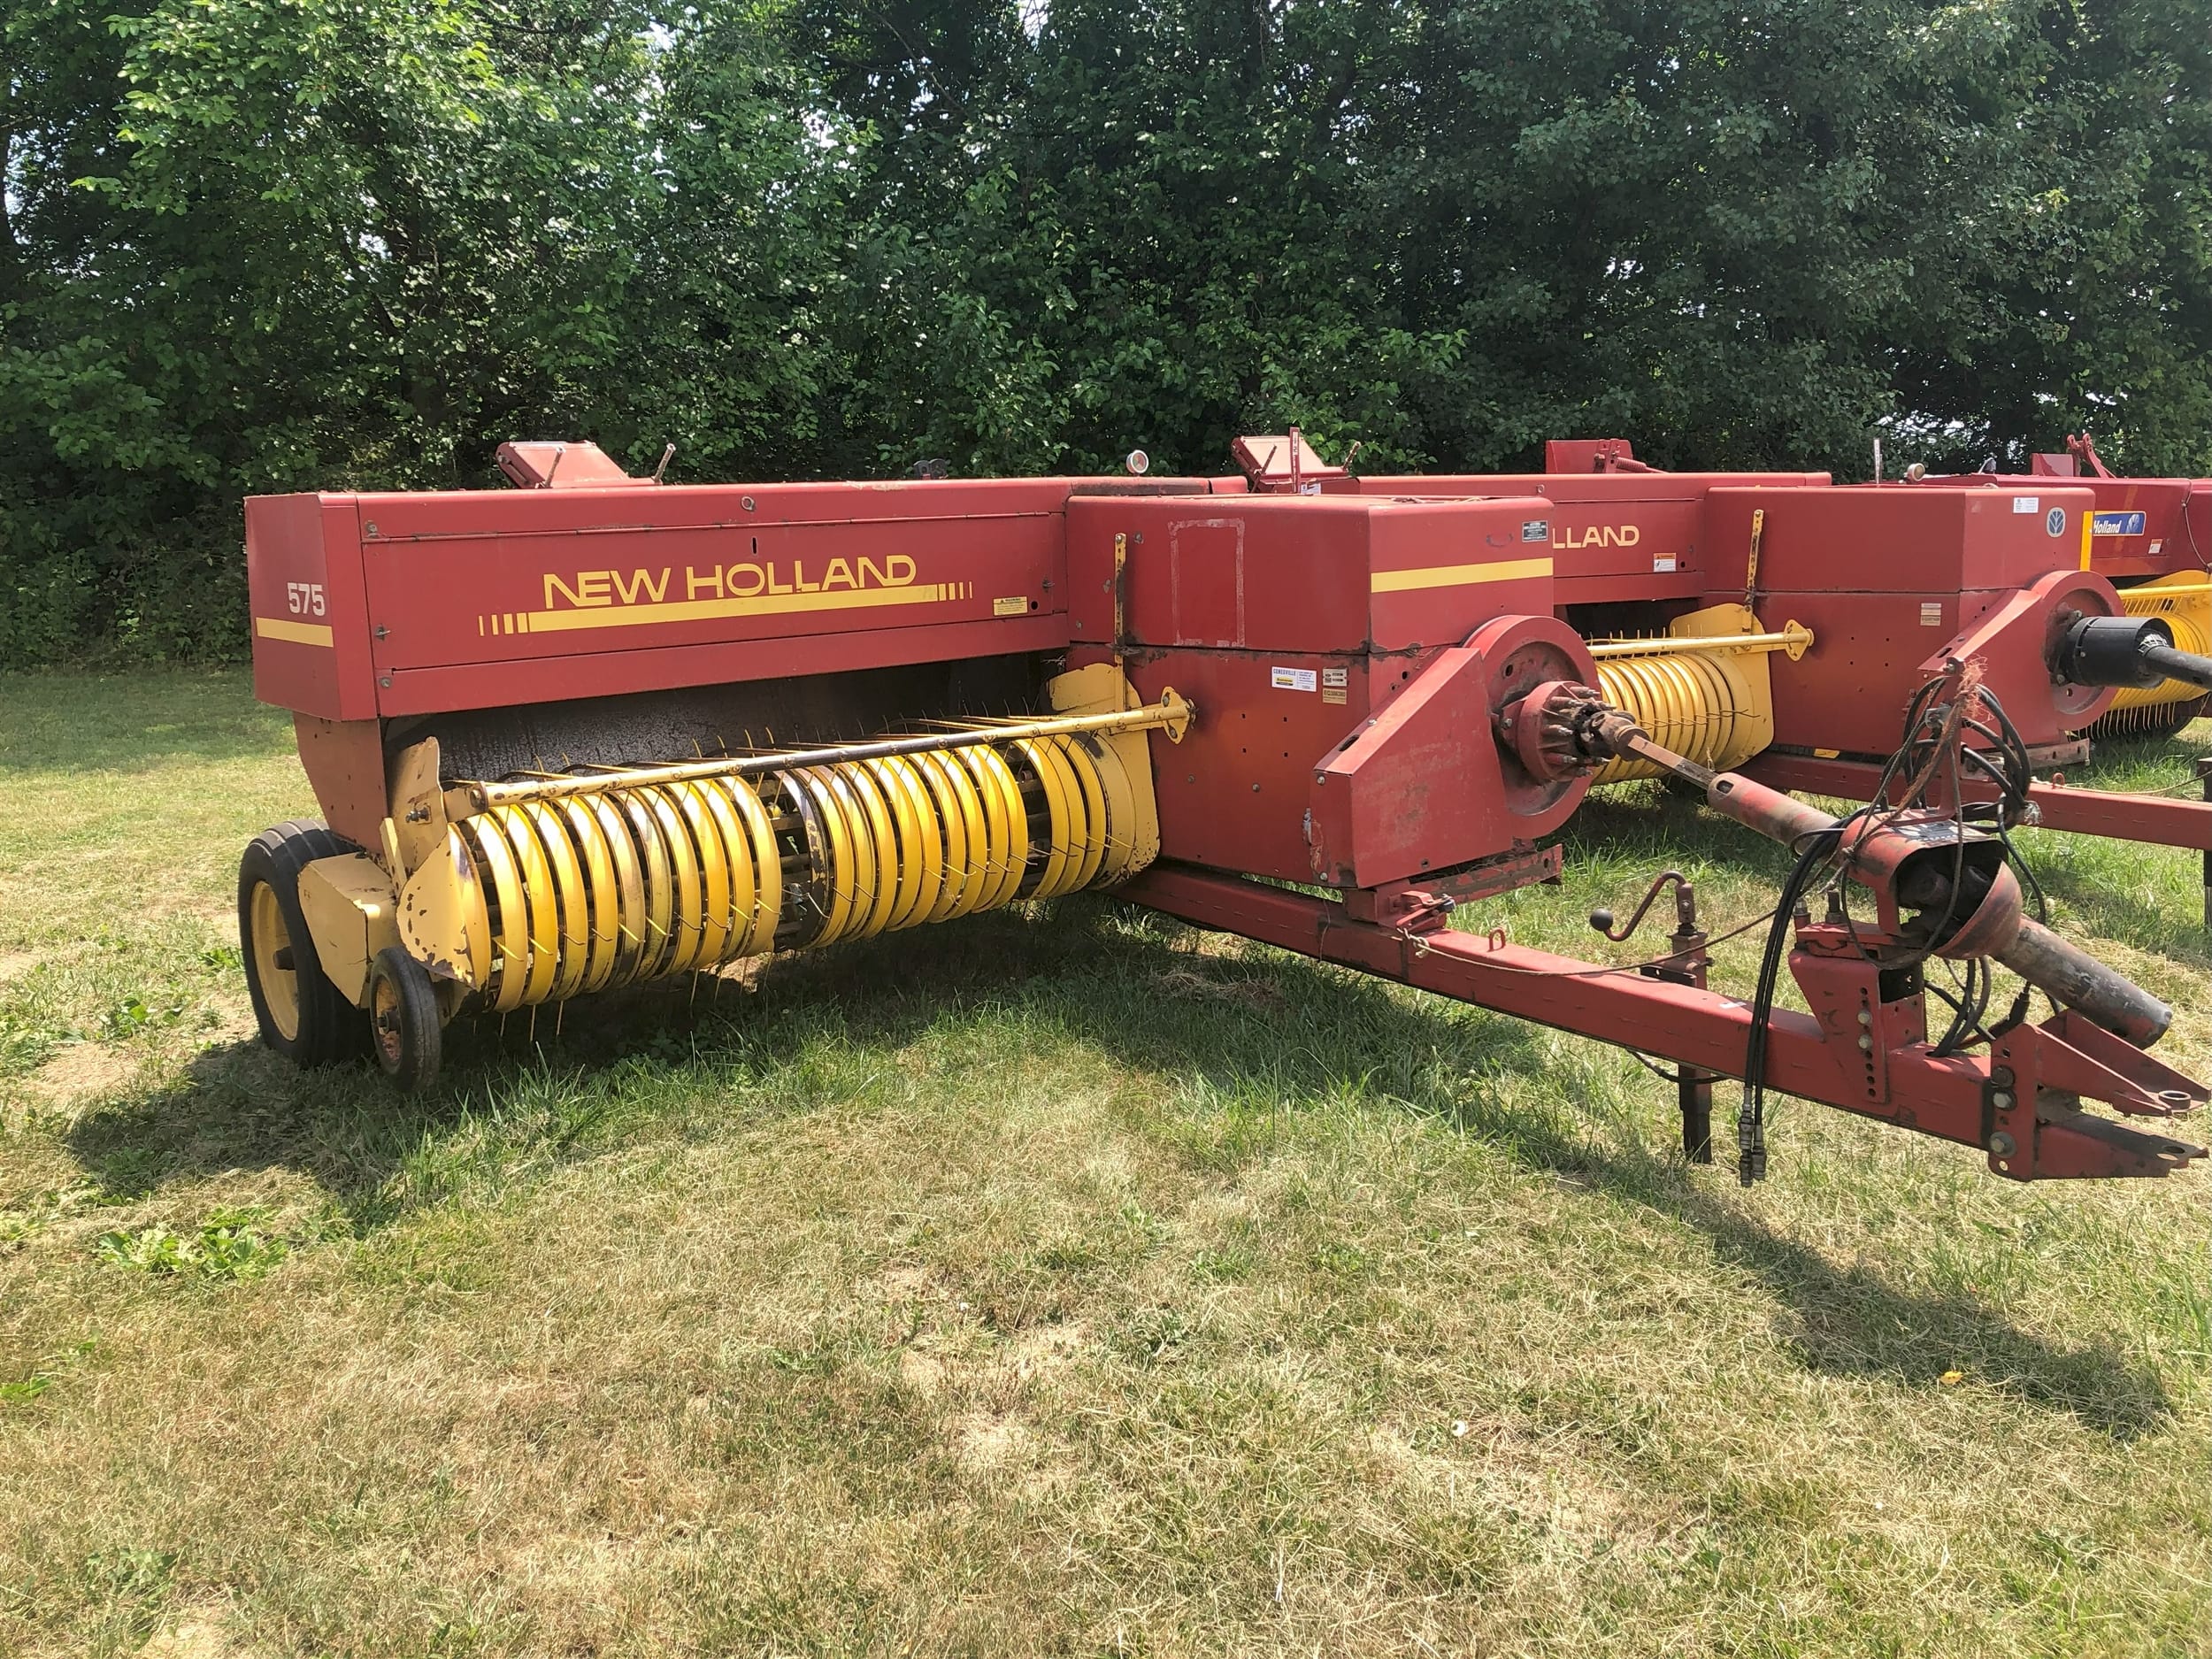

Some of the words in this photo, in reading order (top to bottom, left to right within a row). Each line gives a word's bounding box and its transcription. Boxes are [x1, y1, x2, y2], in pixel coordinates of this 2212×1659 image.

[1552, 525, 1640, 549] LLAND
[2093, 519, 2122, 534] Holland
[542, 567, 672, 610] NEW
[686, 554, 918, 601] HOLLAND
[287, 581, 326, 617] 575
